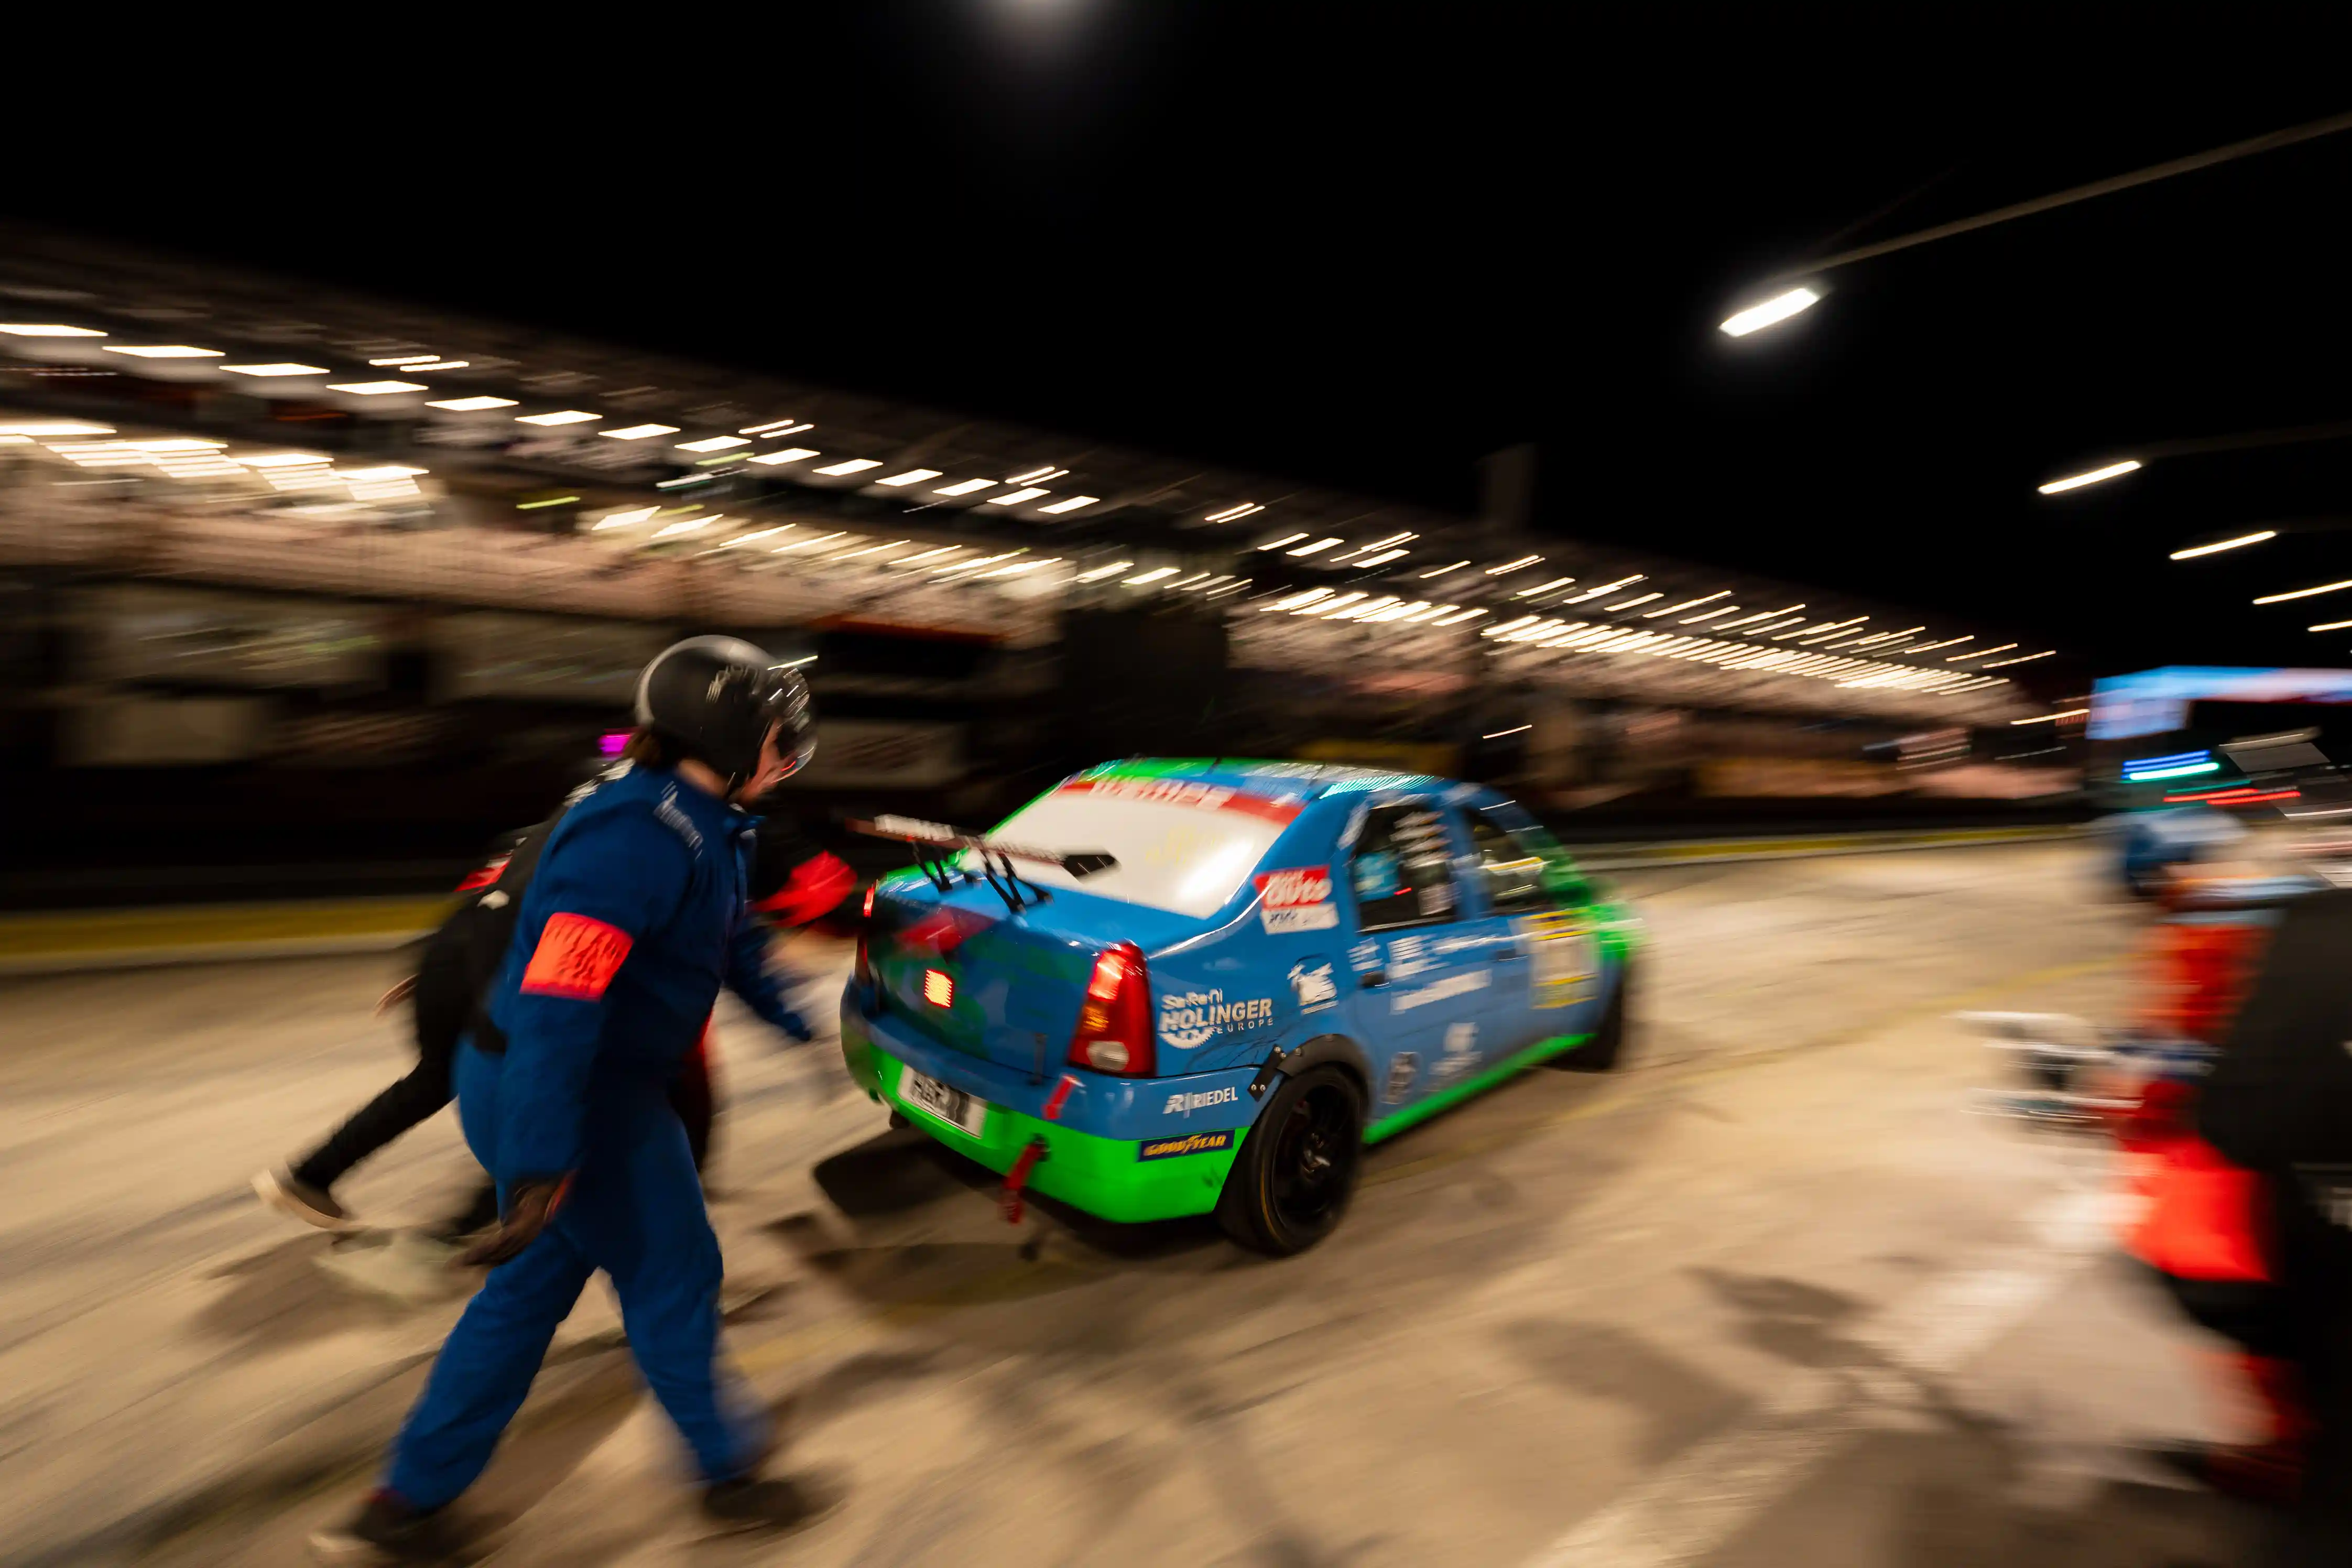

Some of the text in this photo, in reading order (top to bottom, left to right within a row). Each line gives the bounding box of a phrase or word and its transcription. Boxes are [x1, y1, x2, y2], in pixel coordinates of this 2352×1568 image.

[1159, 998, 1272, 1032] HOLINGER
[1216, 1017, 1273, 1034] EUROPE
[1192, 1087, 1238, 1109] RIEDEL
[1143, 1134, 1227, 1156] GOODYEAR
